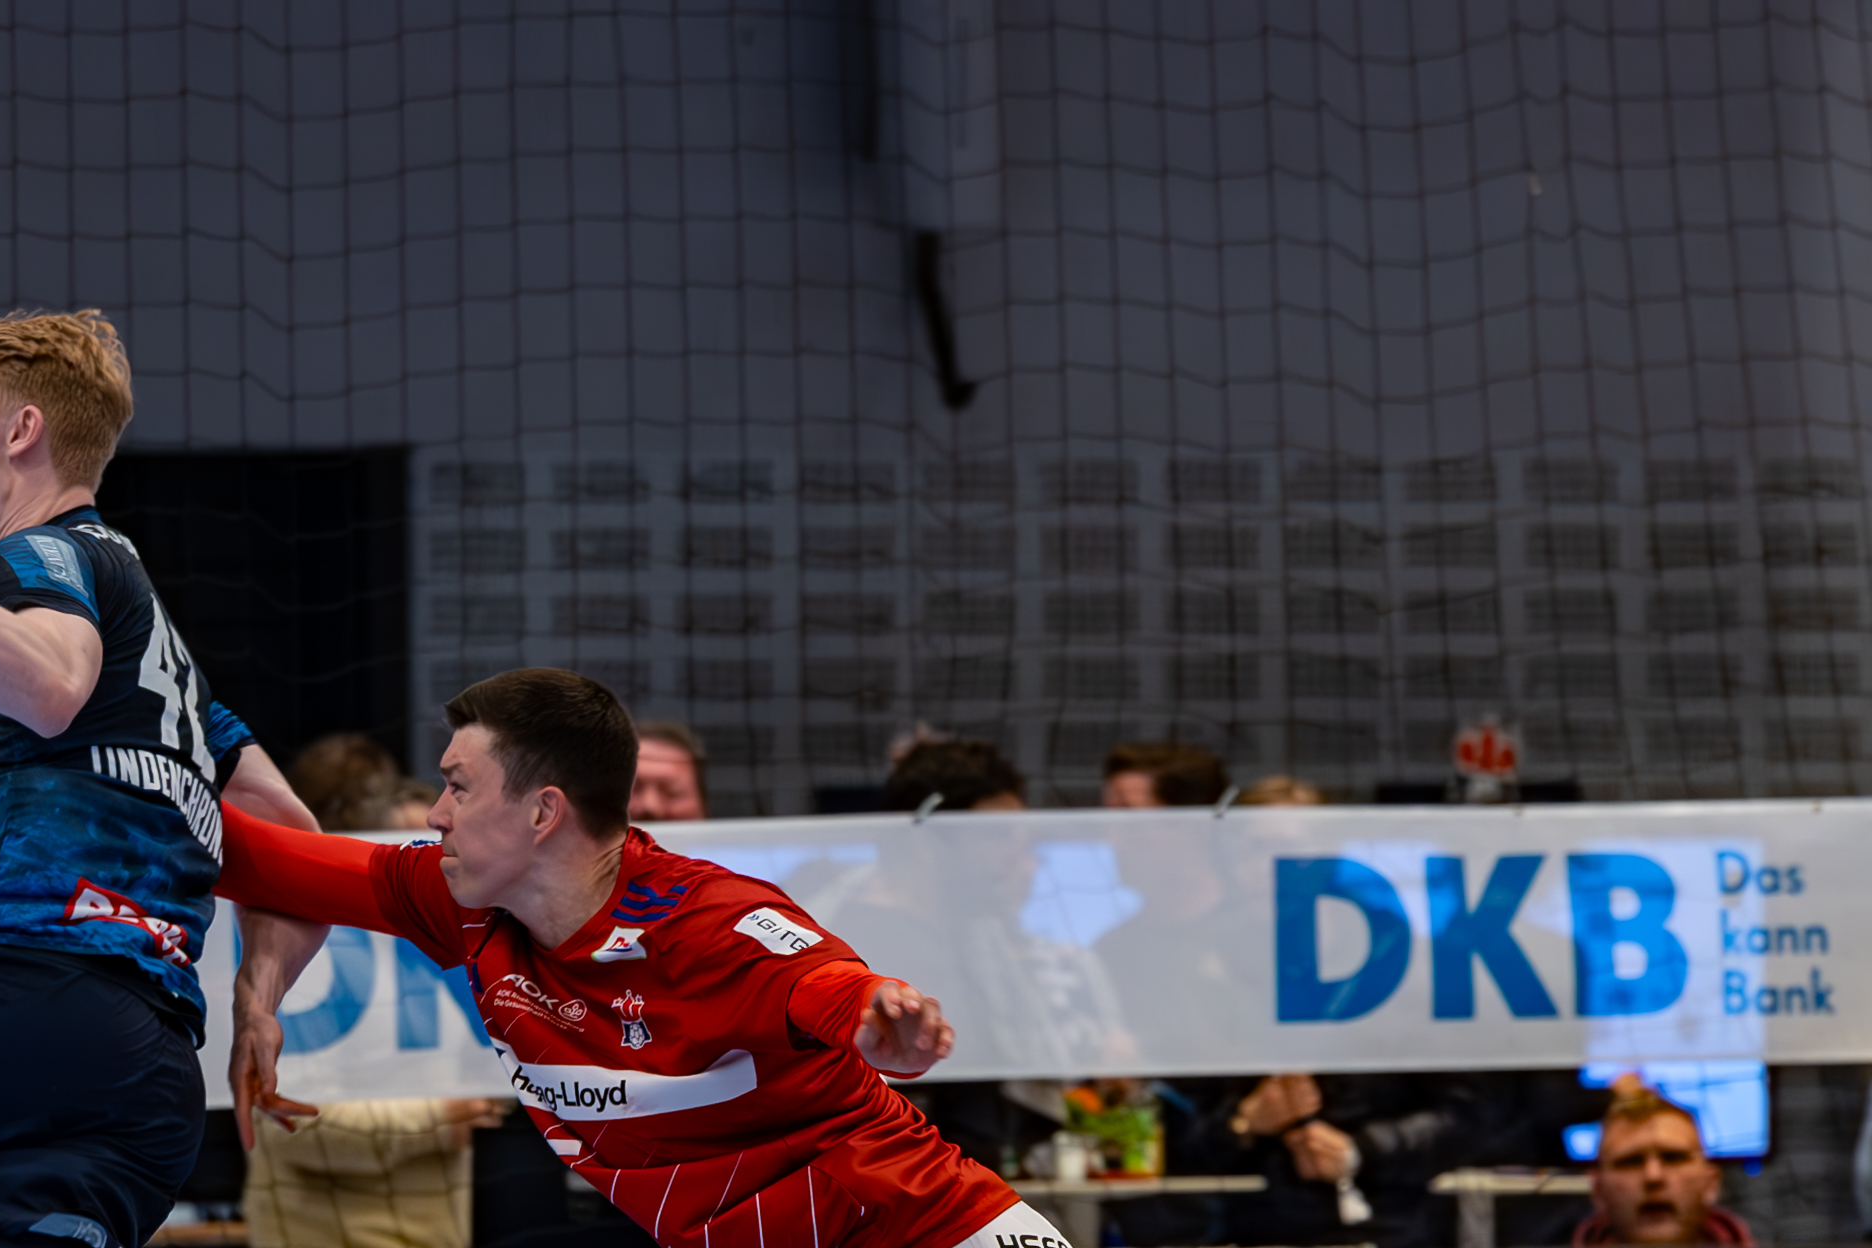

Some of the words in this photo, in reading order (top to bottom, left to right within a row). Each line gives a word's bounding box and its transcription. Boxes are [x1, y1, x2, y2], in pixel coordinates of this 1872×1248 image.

[1715, 850, 1805, 896] Das
[1274, 852, 1688, 1023] DKB
[1720, 909, 1830, 955] kann
[503, 973, 559, 1010] AOK
[1722, 967, 1836, 1017] Bank
